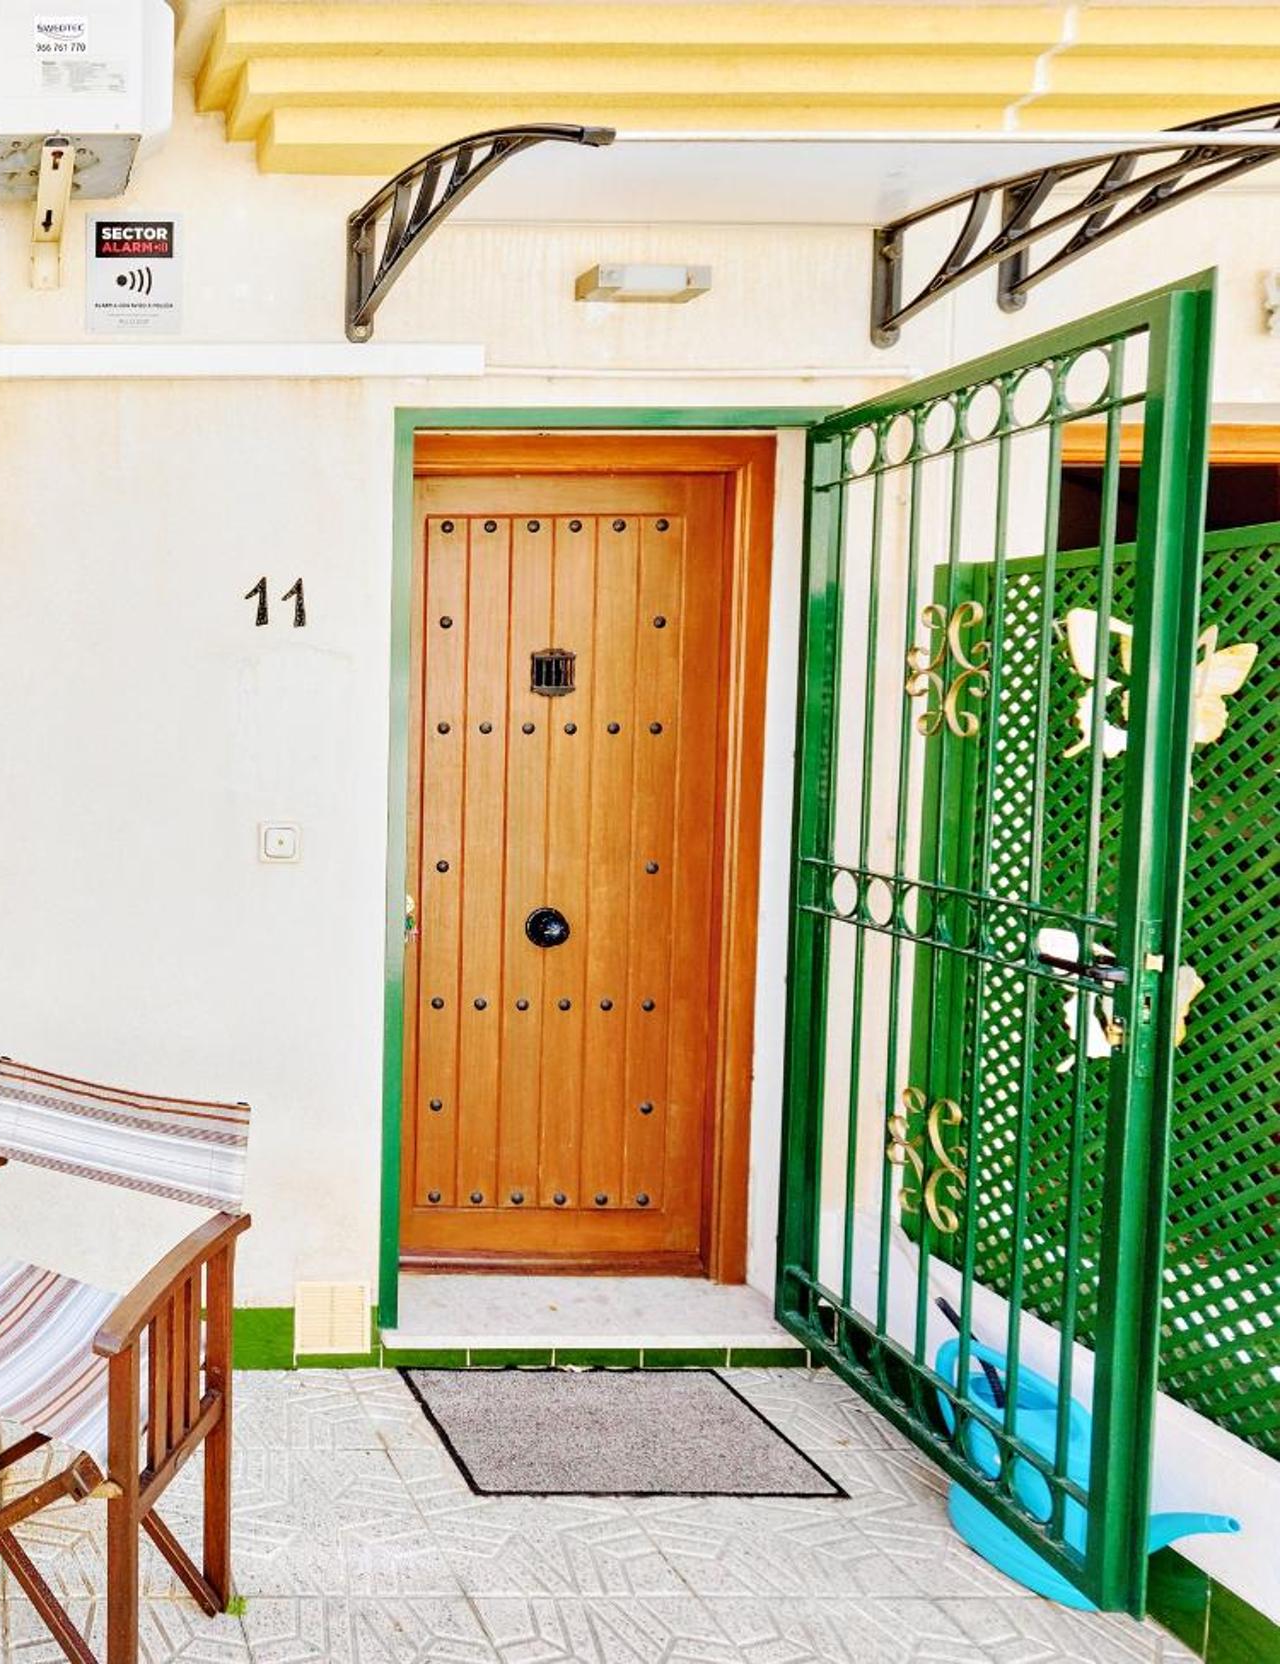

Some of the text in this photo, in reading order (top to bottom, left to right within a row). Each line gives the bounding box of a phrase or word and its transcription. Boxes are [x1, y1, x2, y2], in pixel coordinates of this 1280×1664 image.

[54, 42, 67, 52] 761
[70, 42, 86, 52] 770
[102, 227, 168, 240] SECTOR
[102, 242, 153, 253] ALARM
[244, 576, 306, 628] 11
